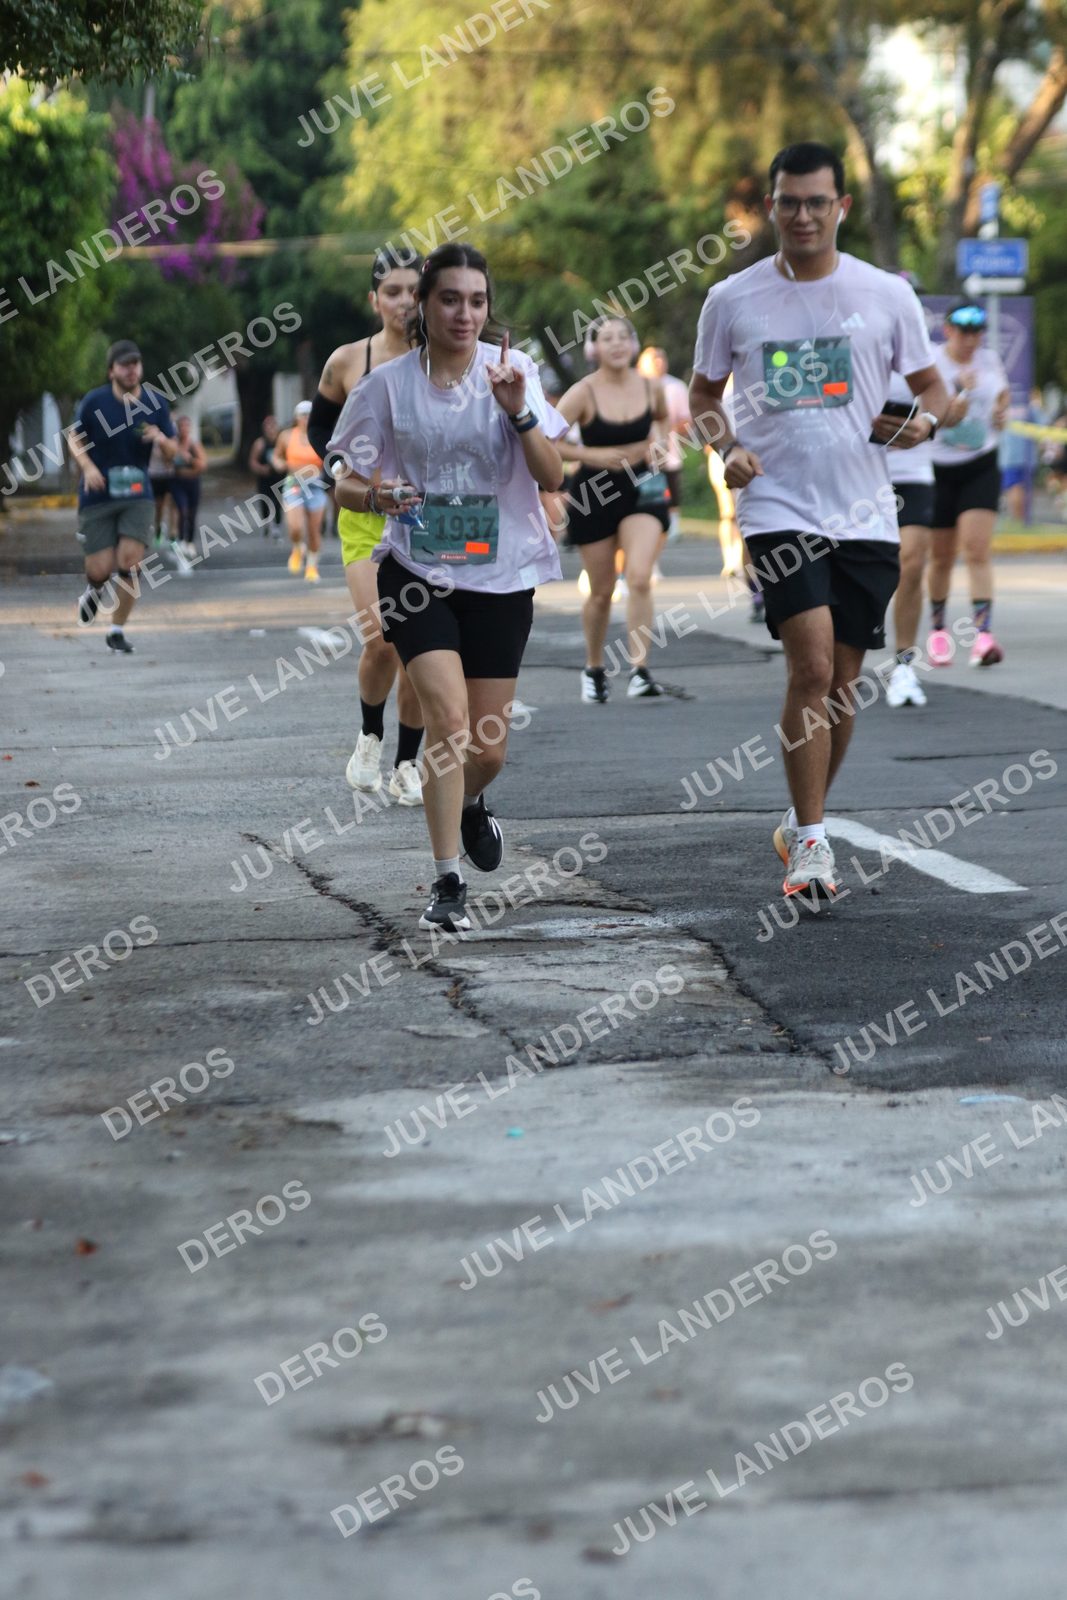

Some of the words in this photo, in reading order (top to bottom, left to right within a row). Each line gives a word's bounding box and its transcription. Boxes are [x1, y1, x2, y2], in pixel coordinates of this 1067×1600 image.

[440, 479, 454, 491] 30
[455, 461, 476, 491] K
[435, 515, 496, 542] 1937
